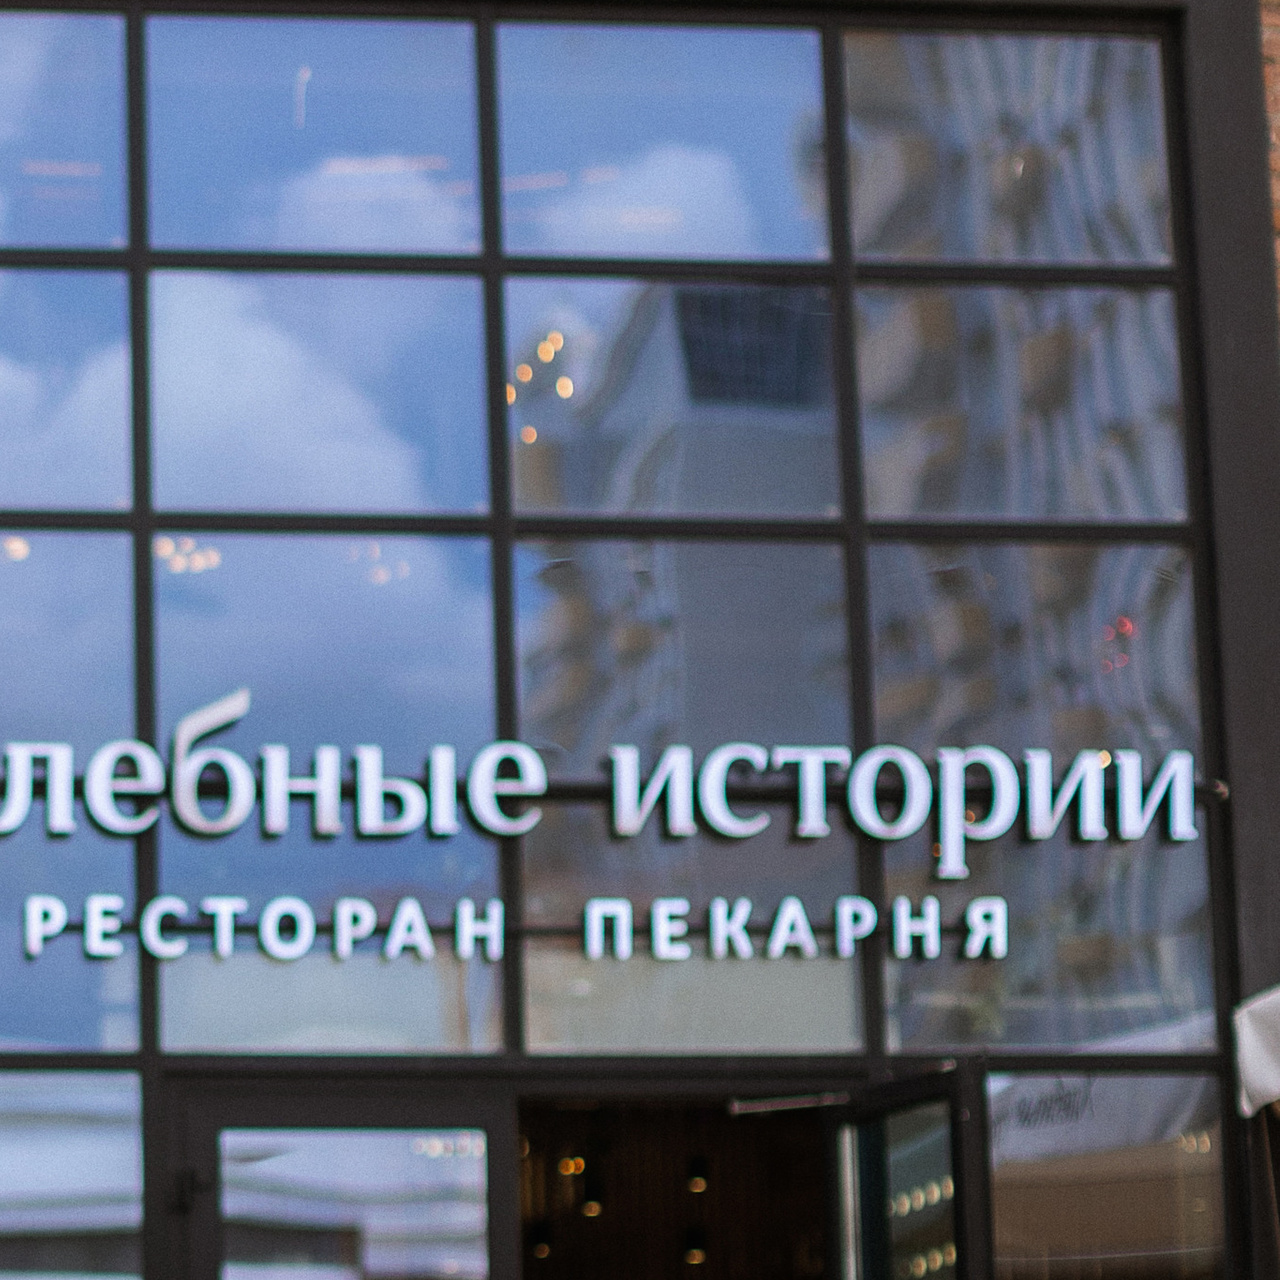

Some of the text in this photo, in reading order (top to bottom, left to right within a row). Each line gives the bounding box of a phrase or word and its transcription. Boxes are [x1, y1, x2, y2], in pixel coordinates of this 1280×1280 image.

[609, 743, 1199, 879] истории
[23, 893, 1009, 962] РЕСТОРАН ПЕКАРНЯ
